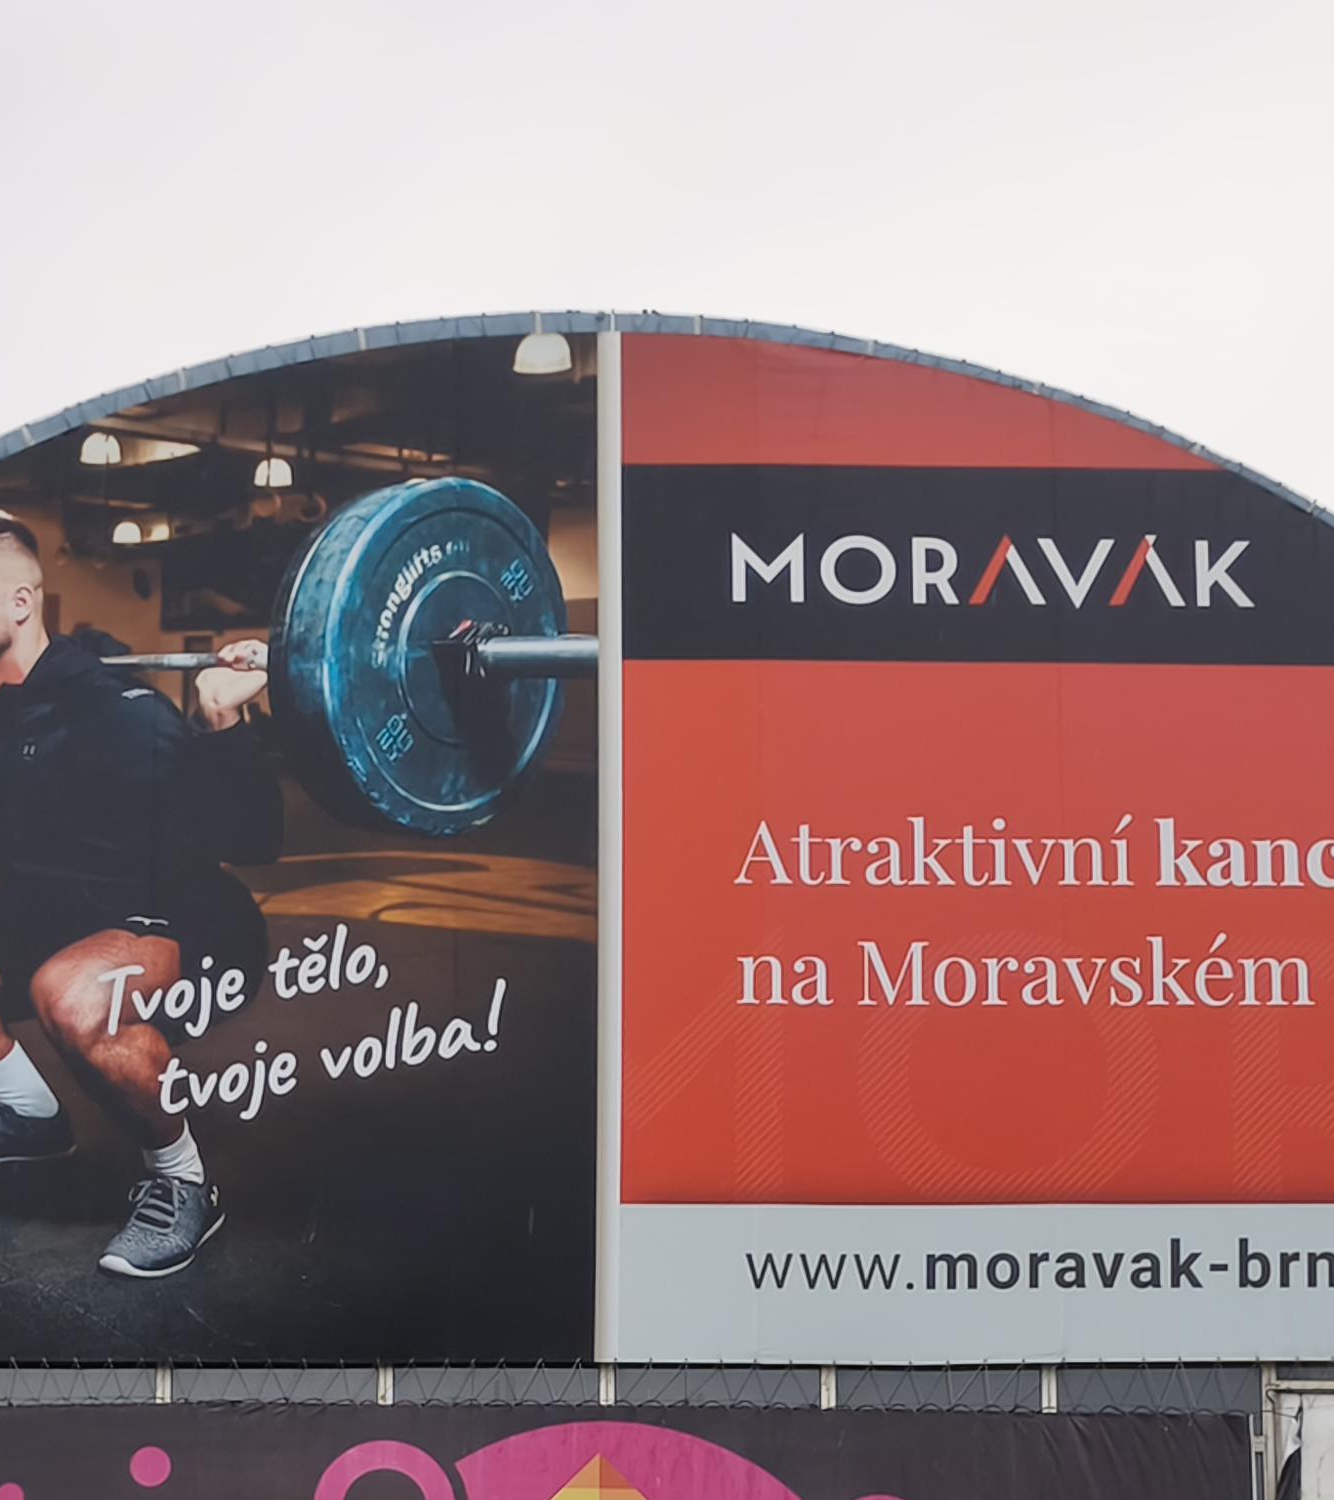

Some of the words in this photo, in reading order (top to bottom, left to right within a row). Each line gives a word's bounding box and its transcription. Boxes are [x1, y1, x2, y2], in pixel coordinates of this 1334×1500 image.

[733, 813, 1135, 888] Atraktivní
[97, 956, 246, 1037] Tvoje
[268, 923, 389, 1000] tělo,
[735, 948, 833, 1007] na
[856, 932, 1315, 1009] Moravském
[159, 1040, 298, 1121] tvoje
[320, 978, 507, 1079] volba!
